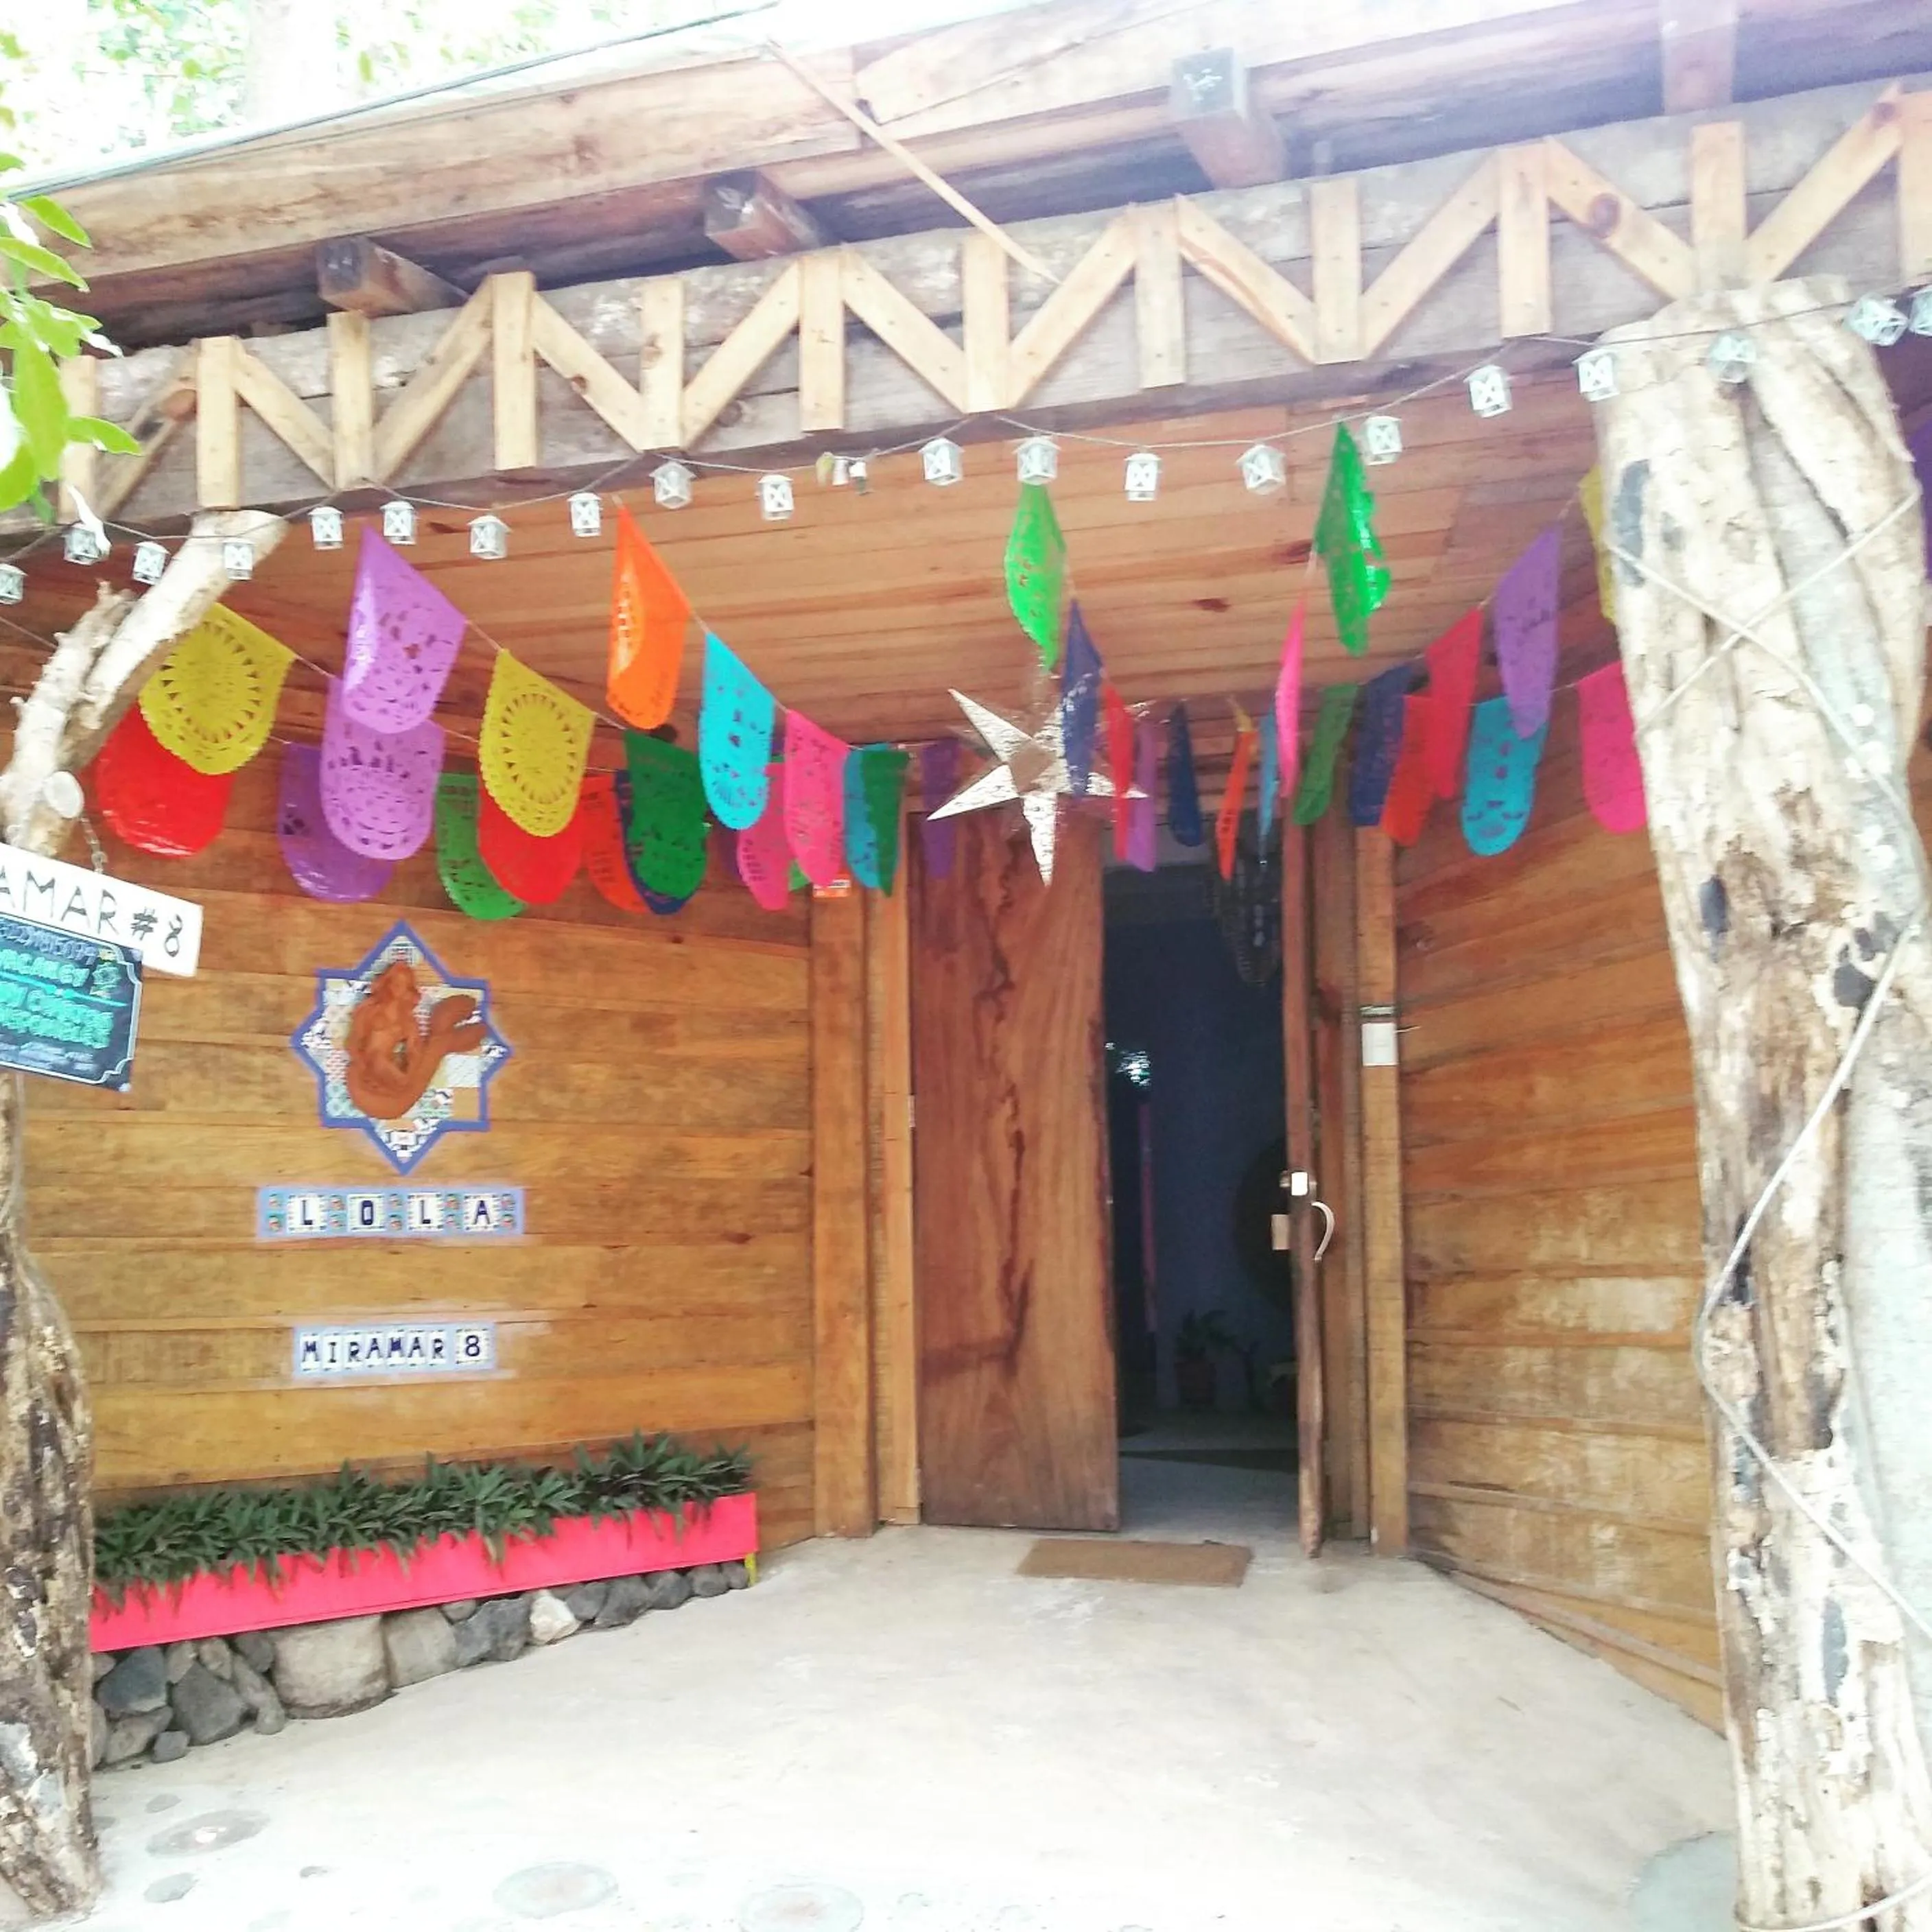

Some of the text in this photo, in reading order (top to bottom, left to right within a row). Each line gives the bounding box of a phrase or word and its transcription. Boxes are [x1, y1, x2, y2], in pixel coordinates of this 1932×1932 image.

[301, 1199, 491, 1226] LOLA
[302, 1334, 482, 1364] MIRAMAR 8
